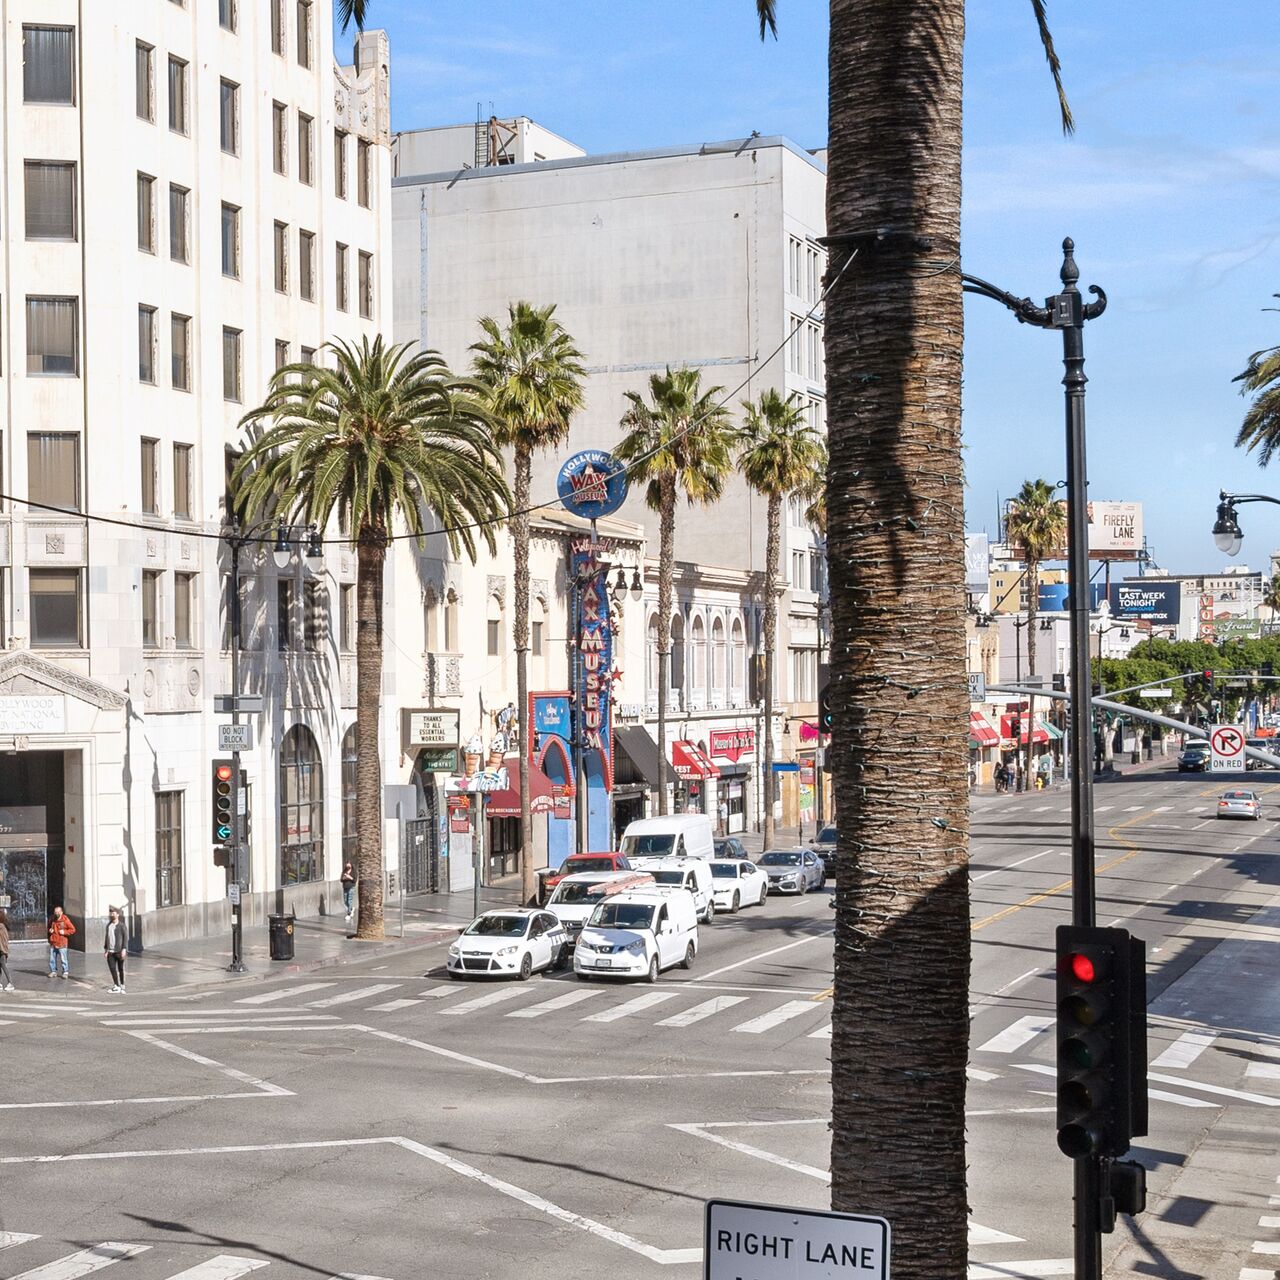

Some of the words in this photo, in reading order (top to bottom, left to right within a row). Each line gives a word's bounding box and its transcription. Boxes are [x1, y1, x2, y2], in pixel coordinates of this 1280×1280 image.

[570, 473, 607, 491] WAX
[573, 491, 607, 500] MUSEUM
[1103, 514, 1134, 526] FIREFLY
[1113, 527, 1134, 539] LANE
[1119, 599, 1156, 607] TONIGHT
[580, 629, 604, 749] MUSEUM
[12, 710, 60, 719] NATIONAL
[233, 727, 244, 735] NOT
[224, 735, 242, 743] BLOCK
[1213, 760, 1224, 768] ON
[1226, 760, 1242, 768] RED
[718, 1230, 794, 1259] RIGHT
[806, 1240, 875, 1270] LANE
